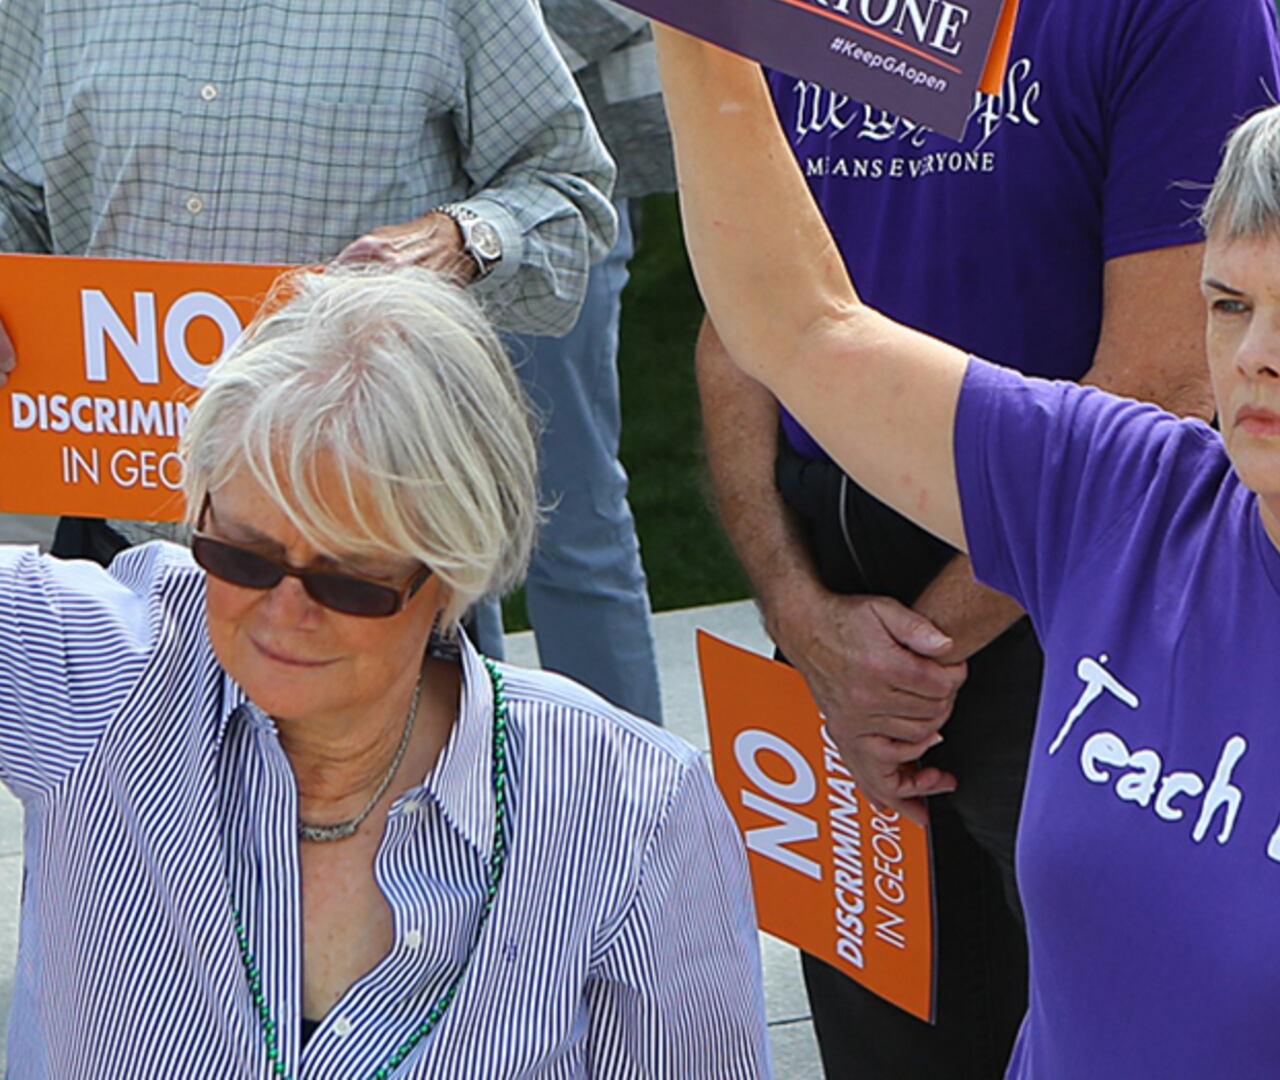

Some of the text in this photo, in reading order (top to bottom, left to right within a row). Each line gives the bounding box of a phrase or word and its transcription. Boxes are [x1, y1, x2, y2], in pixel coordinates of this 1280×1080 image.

[830, 35, 948, 92] #KeepGAopen
[79, 287, 245, 391] NO
[10, 392, 194, 437] DISCRIMIN
[61, 446, 100, 485] IN
[1048, 653, 1247, 845] Teach
[732, 728, 823, 881] NO
[874, 904, 906, 950] IN
